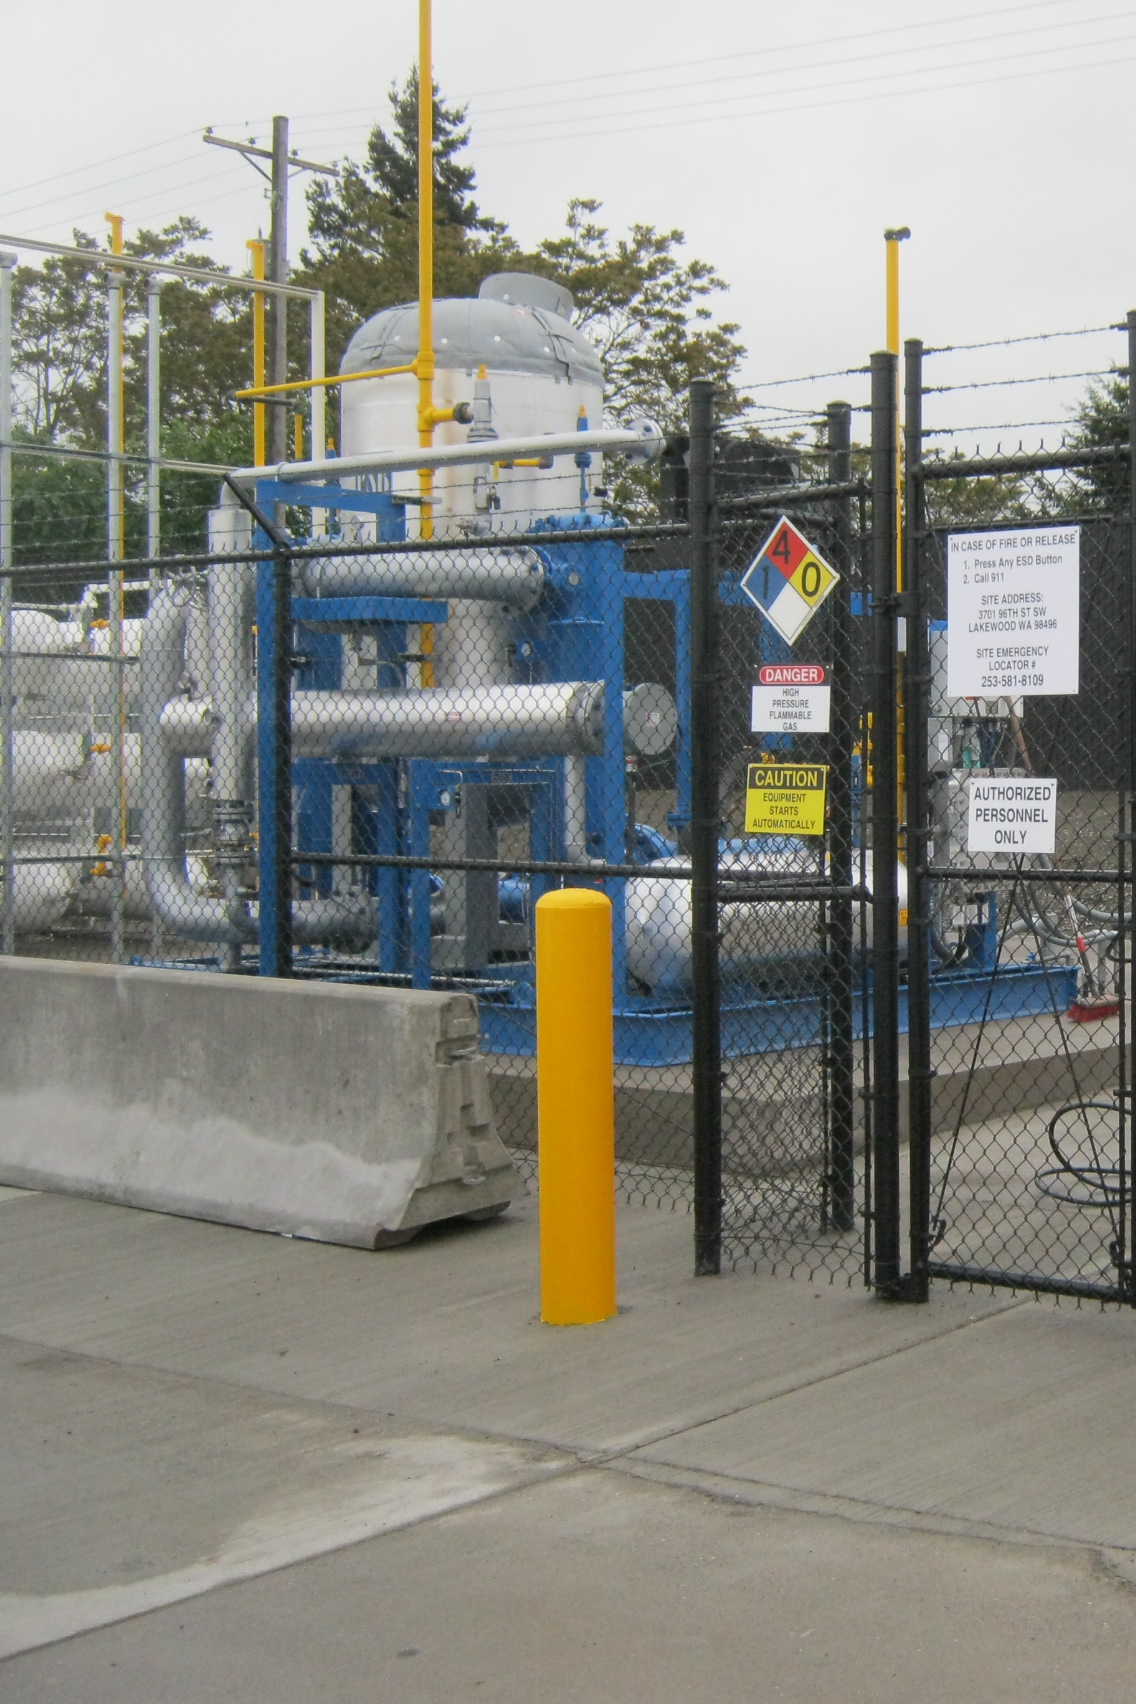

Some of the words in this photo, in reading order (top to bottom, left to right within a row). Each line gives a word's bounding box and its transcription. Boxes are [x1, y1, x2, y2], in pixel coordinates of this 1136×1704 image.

[773, 530, 791, 564] 4
[951, 542, 959, 552] IN
[961, 540, 984, 551] CASE
[986, 539, 997, 550] OF
[1000, 538, 1018, 549] FIRE
[1020, 536, 1033, 548] OR
[1035, 534, 1076, 546] RELEASE
[964, 560, 970, 569] 1.
[974, 558, 996, 569] Press
[999, 557, 1014, 569] Any
[1016, 555, 1034, 566] ESD
[1036, 554, 1063, 565] Button
[762, 565, 769, 600] 1
[802, 562, 821, 597] 0
[963, 574, 970, 584] 2.
[974, 573, 989, 584] Call
[991, 572, 1005, 582] 911
[981, 594, 999, 606] SITE
[1002, 592, 1044, 605] ADDRESS:
[978, 609, 996, 620] 3701
[998, 608, 1018, 619] 96TH
[1020, 607, 1032, 618] ST
[1033, 606, 1047, 617] SW
[968, 621, 1016, 632] LAKEWOOD
[1018, 620, 1032, 630] WA
[976, 648, 994, 659] SITE
[997, 646, 1049, 658] EMERGENCY
[989, 660, 1029, 671] LOCATOR
[1031, 660, 1036, 669] #
[765, 668, 818, 682] DANGER
[981, 674, 1044, 688] 253-581-8109
[782, 688, 800, 697] HIGH
[772, 700, 809, 708] PRESSURE
[769, 711, 812, 720] FLAMMABLE
[782, 722, 798, 731] GAS
[755, 770, 818, 787] CAUTION
[763, 792, 807, 803] EQUIPMENT
[974, 786, 1052, 801] AUTHORIZED
[769, 806, 799, 816] STARTS
[975, 808, 1049, 823] PERSONNEL
[752, 818, 816, 830] AUTOMATICALLY
[994, 830, 1027, 845] ONLY
